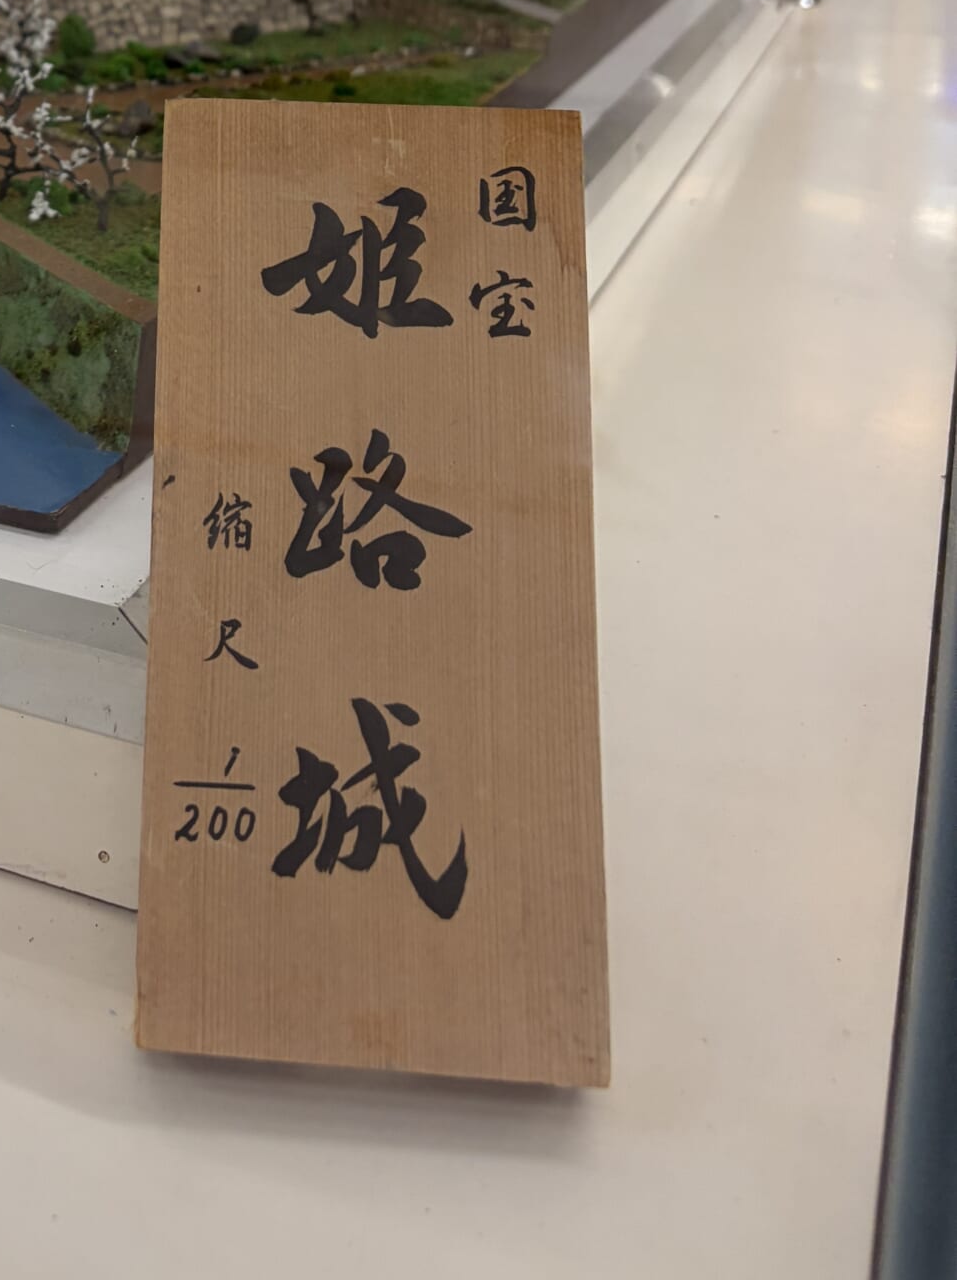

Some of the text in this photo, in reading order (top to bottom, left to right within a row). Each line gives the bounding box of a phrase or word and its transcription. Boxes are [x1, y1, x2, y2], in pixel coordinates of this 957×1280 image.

[468, 165, 537, 339] 国宝
[202, 492, 259, 670] 縮尺
[260, 186, 472, 920] 姫路城
